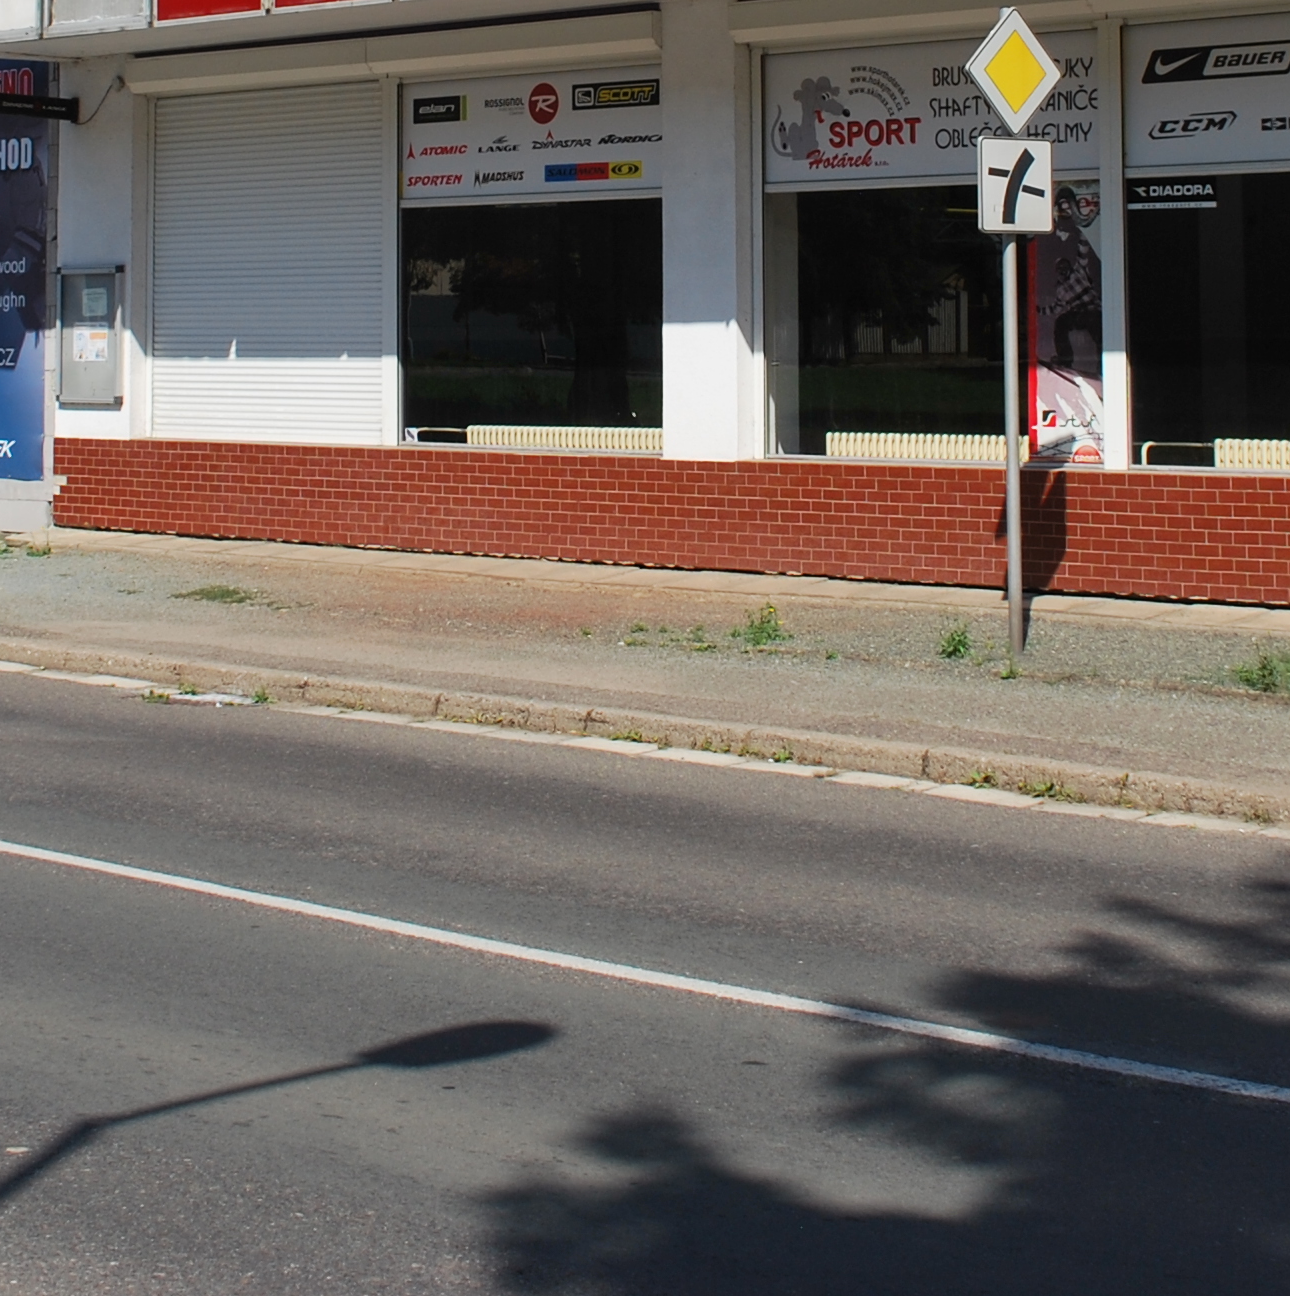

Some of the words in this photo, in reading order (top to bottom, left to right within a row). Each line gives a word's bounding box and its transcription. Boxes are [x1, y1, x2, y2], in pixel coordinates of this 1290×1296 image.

[932, 64, 974, 88] BRUS
[597, 85, 655, 103] SCOTT
[419, 102, 455, 115] elan
[484, 96, 525, 110] ROSSIGNOL
[1156, 115, 1228, 134] CCM
[828, 117, 922, 148] SPORT
[1027, 121, 1093, 143] HELMY
[419, 144, 469, 157] ATOMIC
[478, 144, 521, 154] LANGE
[531, 138, 592, 150] DYNASTAR
[806, 148, 874, 170] Hotárek
[480, 170, 525, 184] MADSHUS
[546, 164, 606, 178] SALOMON
[407, 174, 463, 187] SPORTEN
[1149, 183, 1215, 197] DIADORA
